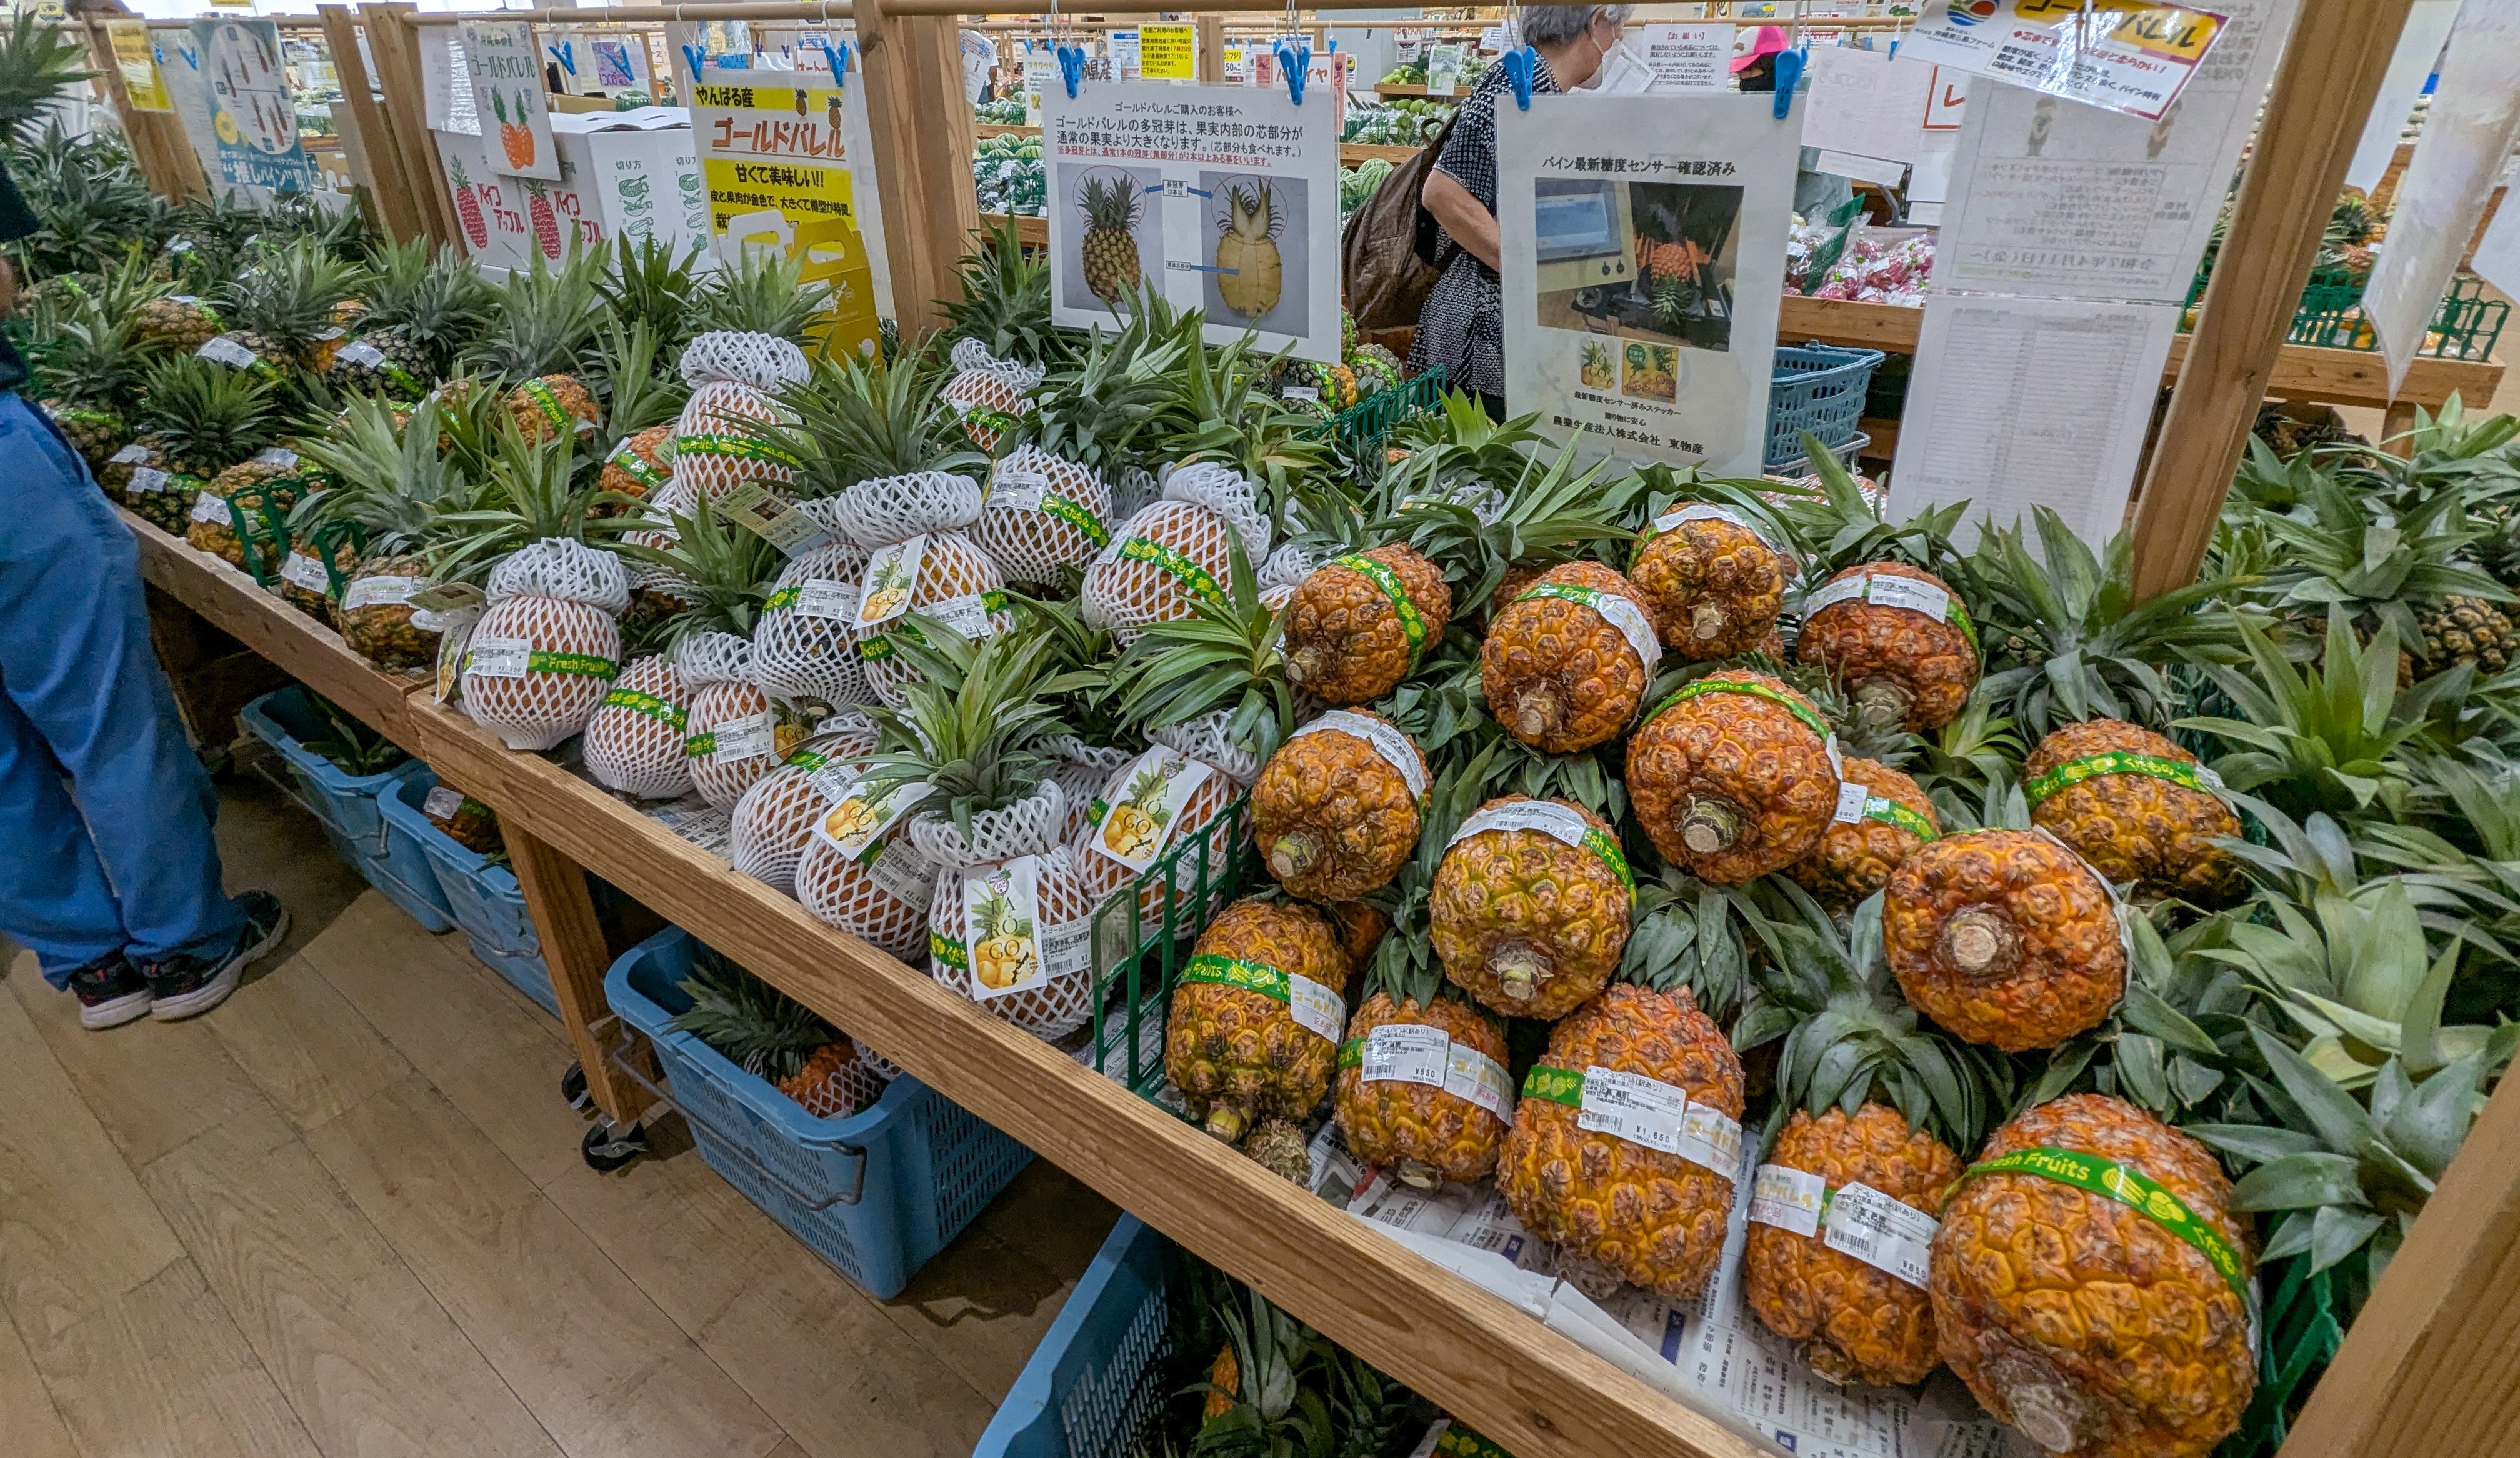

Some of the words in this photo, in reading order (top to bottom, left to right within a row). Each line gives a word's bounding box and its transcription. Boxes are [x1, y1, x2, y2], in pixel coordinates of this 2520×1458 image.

[471, 55, 536, 78] ゴールドバレル
[696, 86, 755, 108] やんばる産
[1116, 102, 1242, 117] ゴールドバレルご購入のお客様へ
[712, 117, 846, 157] ゴールドバレル
[1056, 116, 1303, 141] ゴールドバレルの多冠芽は、果実内部の芯部分が
[1057, 131, 1301, 157] 通常の果実より大きくなります。(芯部分も食べれます。)
[615, 160, 641, 171] 切り方
[735, 163, 824, 187] 甘くて美味しい!!
[1542, 156, 1736, 177] パイン最新糖度センサー確認済み
[1574, 391, 1681, 417] 最新糖度センサー済みステッカー
[1604, 412, 1647, 426] 贈り物に安心
[1553, 416, 1661, 447] 農業生産法人株式会社
[1669, 438, 1704, 455] 東物産
[1062, 505, 1089, 529] くだもの
[1162, 554, 1195, 579] くだもの
[549, 657, 579, 670] Fresh
[581, 659, 608, 672] Fruits
[1699, 682, 1742, 692] Fruits
[784, 727, 805, 741] GO
[1123, 812, 1152, 836] GO
[986, 896, 1016, 915] TA
[989, 918, 1018, 937] RO
[1048, 922, 1082, 934] ゴールドバレル
[989, 939, 1020, 960] GO
[1189, 961, 1222, 979] Fruits
[1415, 1067, 1436, 1078] ¥550
[1636, 1124, 1670, 1144] ¥1,650
[2024, 1153, 2090, 1181] Fruits
